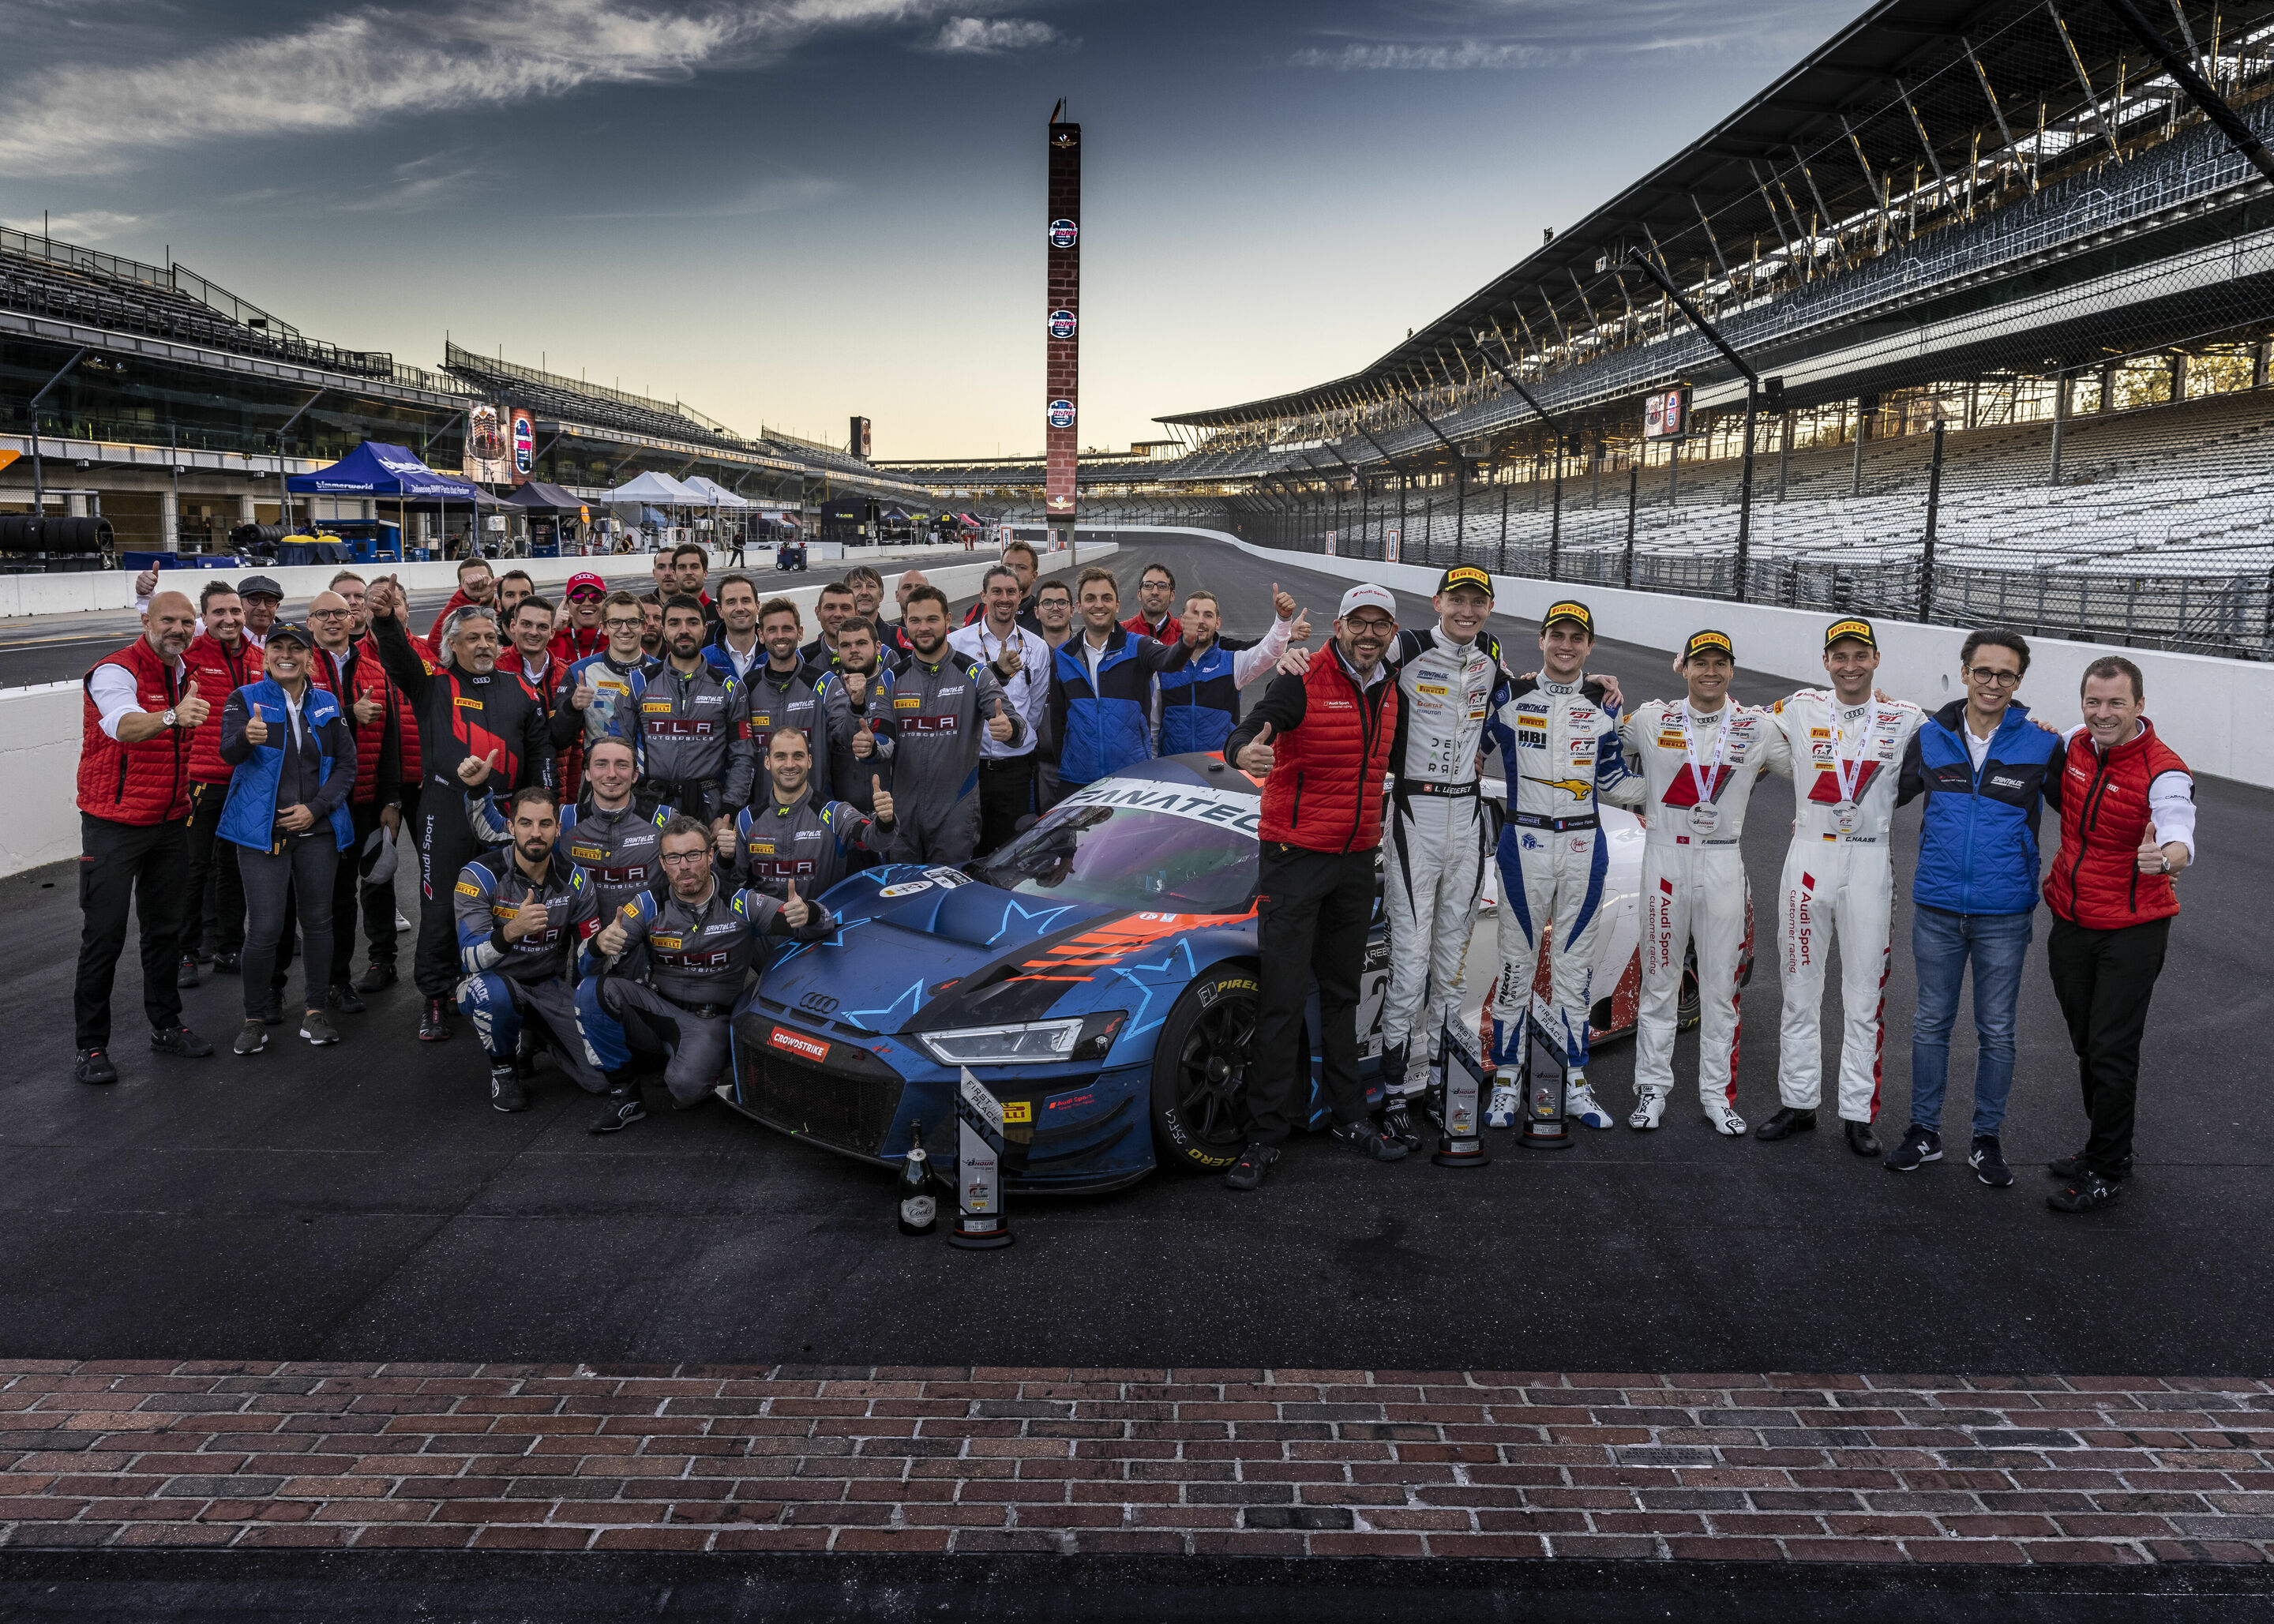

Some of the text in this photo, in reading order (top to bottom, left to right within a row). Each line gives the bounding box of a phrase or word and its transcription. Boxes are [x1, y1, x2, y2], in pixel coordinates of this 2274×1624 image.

[1452, 571, 1485, 582] PIRELLI
[1552, 606, 1585, 618] PIRELLI
[1830, 625, 1867, 636] PIRELLI
[1694, 636, 1728, 647] PIRELLI
[970, 666, 978, 679] P1
[1418, 670, 1449, 679] SAINTéLOC
[816, 681, 825, 696] P1
[1420, 685, 1446, 694] PIRELLI
[456, 699, 482, 708] PIRELLI
[1517, 703, 1549, 712] SAINTéLOC
[651, 722, 711, 733] TLA
[902, 718, 953, 729] TLA
[1520, 718, 1544, 726] PIRELLI
[1518, 730, 1546, 744] HBI
[1992, 776, 2024, 787] SAINTéLOC
[823, 809, 831, 823] P1
[1064, 789, 1261, 834] FANATEC
[655, 812, 666, 828] P1
[424, 815, 434, 851] Sport
[625, 835, 655, 844] SAINTéLOC
[573, 848, 601, 859] PIRELLI
[757, 862, 812, 874] TLA
[573, 873, 582, 890] P1
[573, 873, 583, 891] P1
[734, 898, 743, 913] P1
[706, 922, 737, 932] SAINTéLOC
[1659, 897, 1671, 968] Audi Sport
[1799, 892, 1811, 966] Audi Sport
[523, 929, 558, 943] LA
[652, 937, 679, 948] PIRELLI
[659, 952, 726, 966] TLA
[1649, 947, 1658, 975] racing
[1218, 979, 1259, 992] PIREL
[1203, 988, 1215, 1004] FL
[1537, 1005, 1559, 1026] FIRST
[1452, 1019, 1473, 1041] FIRST
[1541, 1018, 1564, 1042] PLACE
[774, 1033, 824, 1056] CROWDSTRIKE
[1455, 1033, 1478, 1057] PLACE
[966, 1081, 992, 1105] FIRST
[1057, 1097, 1072, 1106] Audi
[1074, 1093, 1093, 1102] Sport
[971, 1096, 999, 1124] PLACE
[1188, 1148, 1236, 1166] ZERO
[910, 1206, 932, 1216] Cook's
